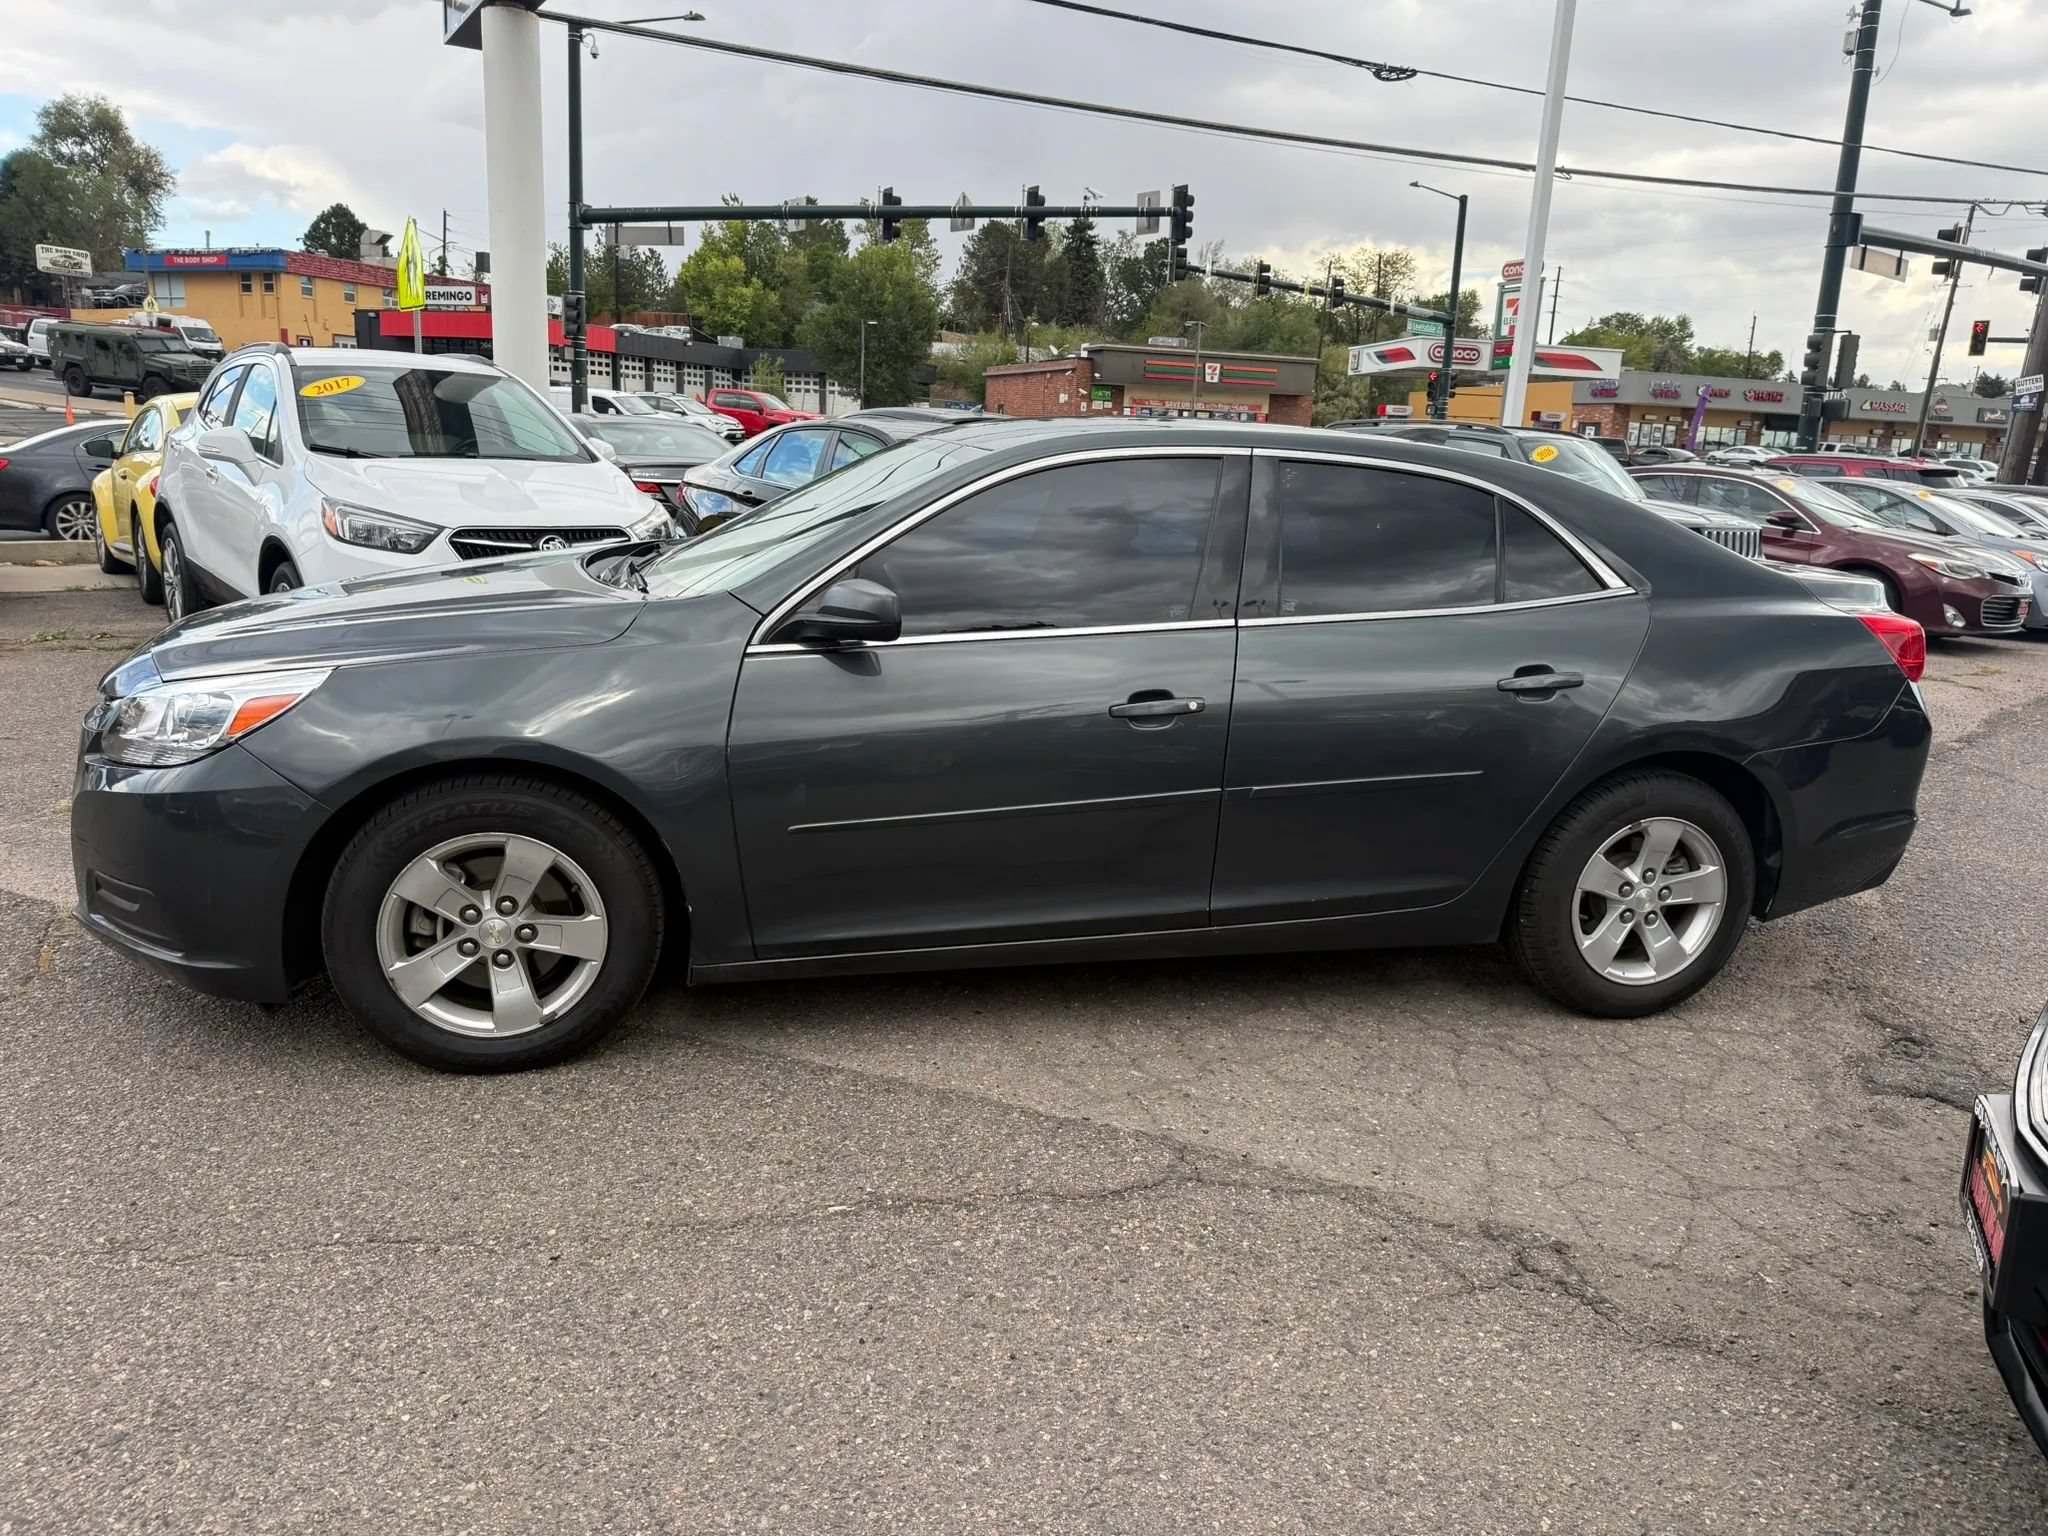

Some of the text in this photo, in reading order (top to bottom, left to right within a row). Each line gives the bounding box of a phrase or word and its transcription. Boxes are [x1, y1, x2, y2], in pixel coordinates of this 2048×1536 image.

[40, 246, 88, 259] THE BODY SHOP
[173, 256, 218, 264] THE BODY SHOP
[1504, 265, 1524, 276] cono
[425, 291, 472, 301] REMINGO
[1503, 317, 1517, 326] ELEV
[312, 377, 351, 395] 2017
[2017, 376, 2043, 387] GUTTERS
[1872, 401, 1910, 413] MASSAGE
[388, 801, 538, 847] STRATUS
